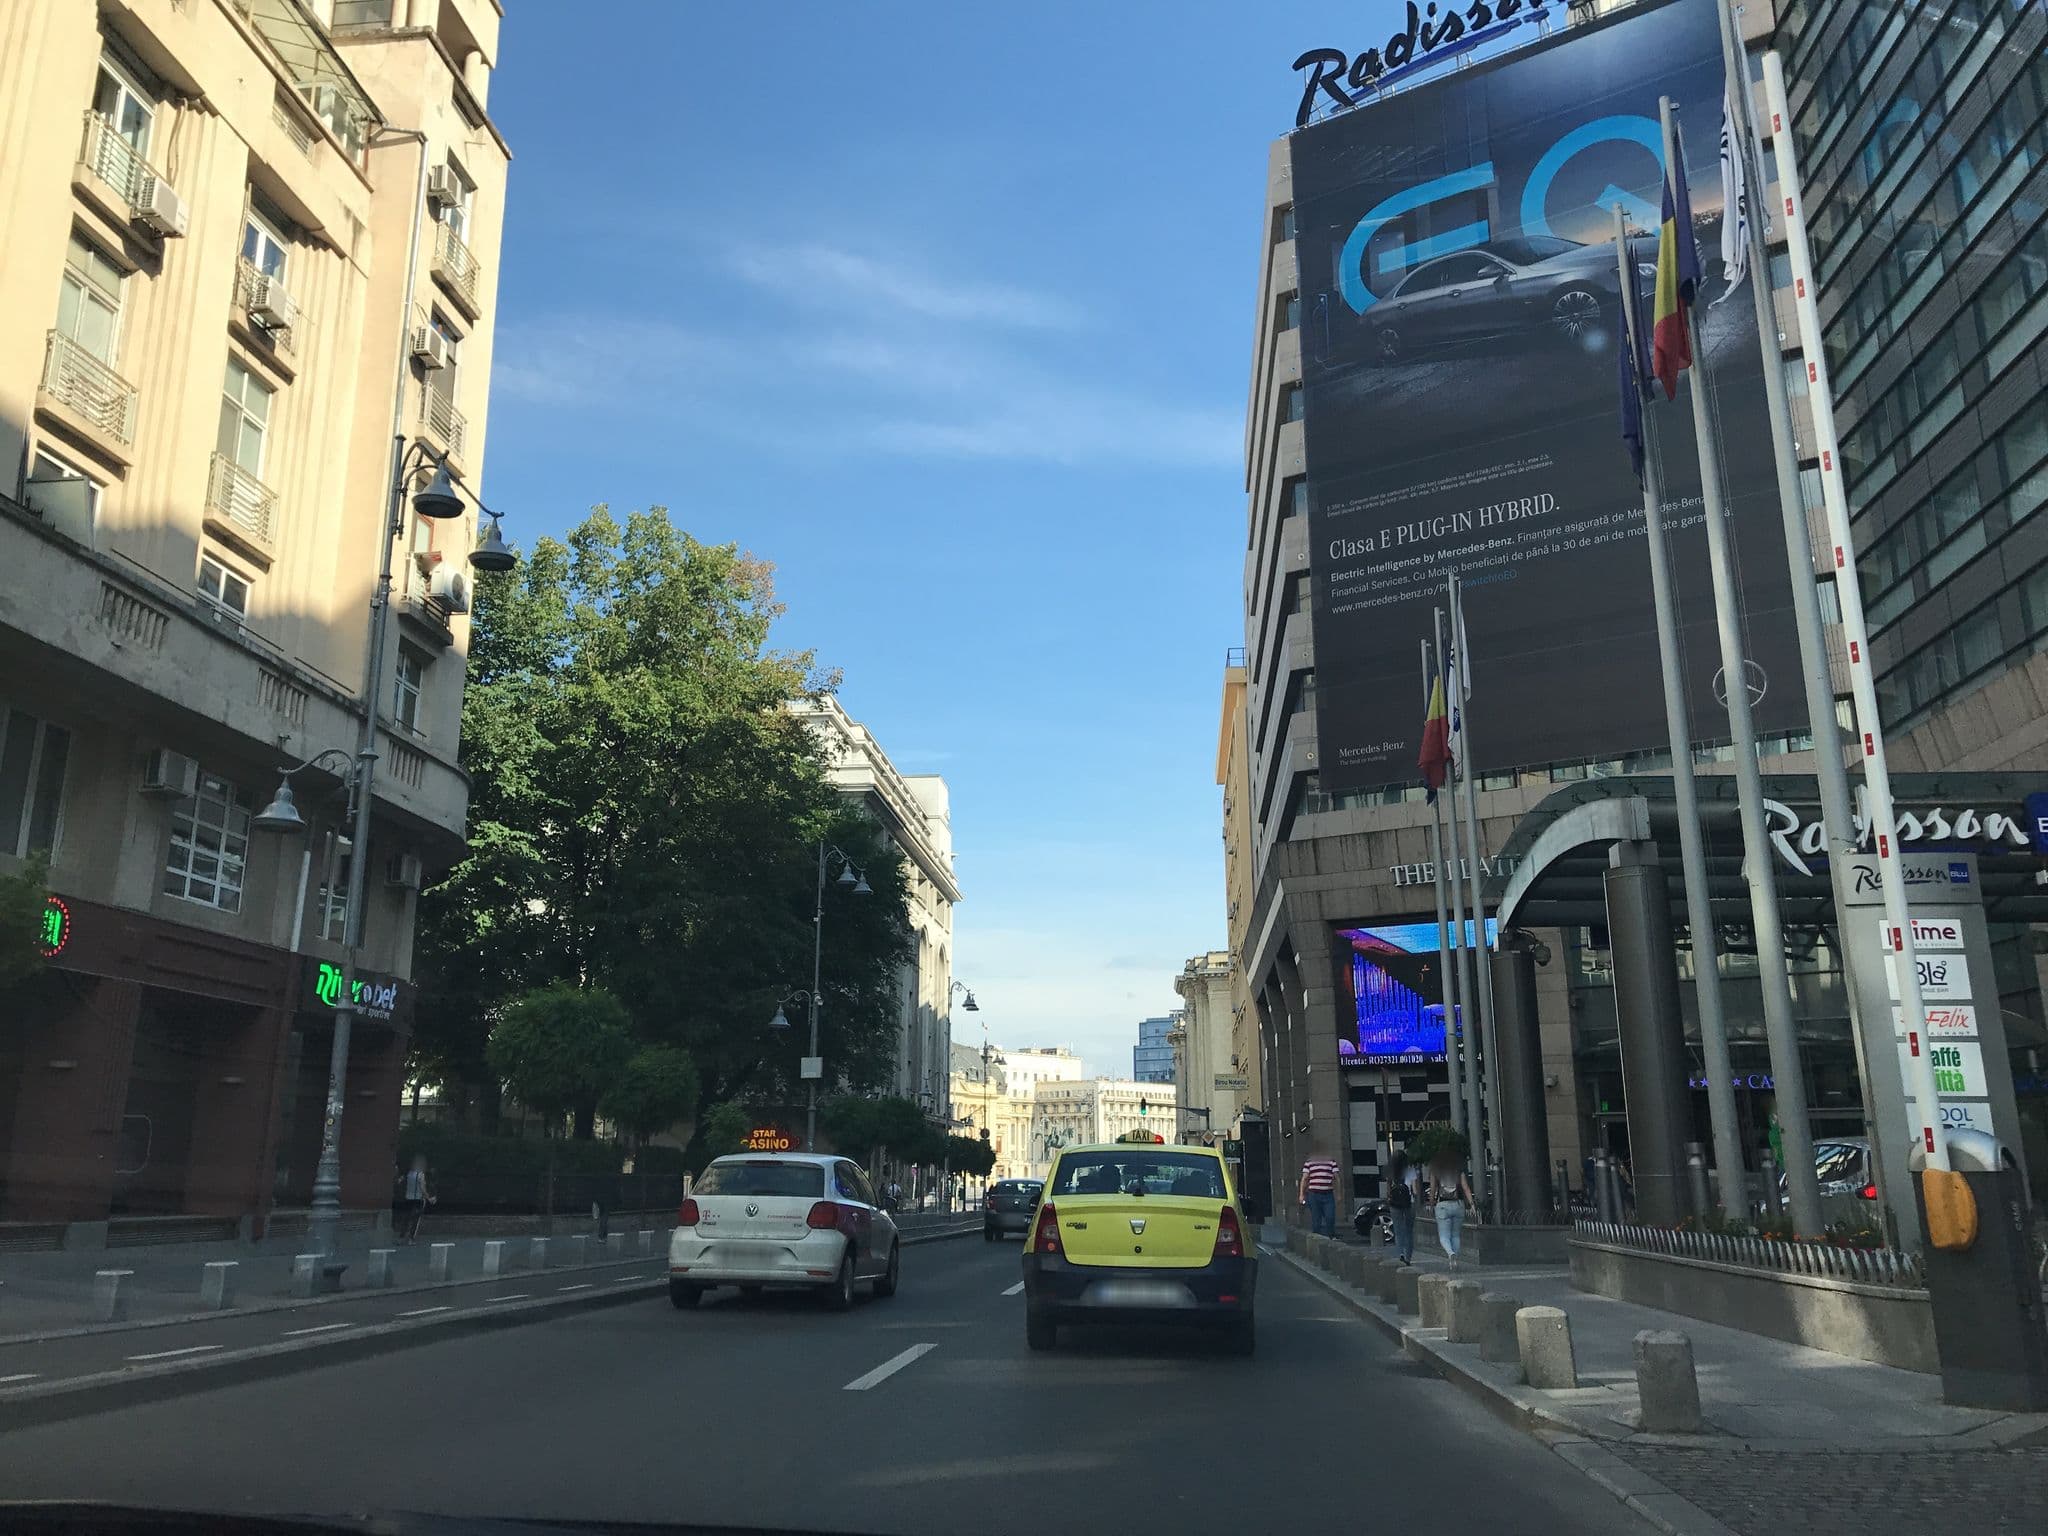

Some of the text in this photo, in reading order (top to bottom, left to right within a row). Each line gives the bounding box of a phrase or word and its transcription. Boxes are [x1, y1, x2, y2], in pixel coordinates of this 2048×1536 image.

[1329, 493, 1560, 560] Clasa E PLUG-IN HYBRID.
[1330, 567, 1365, 583] Electric
[1367, 555, 1421, 575] Intelligence
[1423, 553, 1435, 564] by
[1437, 537, 1515, 560] Mercedes-Benz.
[1564, 515, 1610, 533] asigurată
[1612, 512, 1625, 524] de
[1331, 582, 1369, 599] Financial
[1371, 575, 1411, 591] Services.
[1412, 571, 1426, 582] Cu
[1428, 564, 1459, 580] Mobilo
[1511, 550, 1524, 561] de
[1552, 543, 1560, 553] la
[1563, 539, 1576, 551] 30
[1579, 537, 1592, 548] de
[1594, 532, 1609, 544] ani
[1612, 530, 1624, 541] de
[1390, 862, 1436, 887] THE
[1926, 1008, 1969, 1028] Felix
[753, 1129, 776, 1138] STAR
[1132, 1130, 1150, 1141] TAXI
